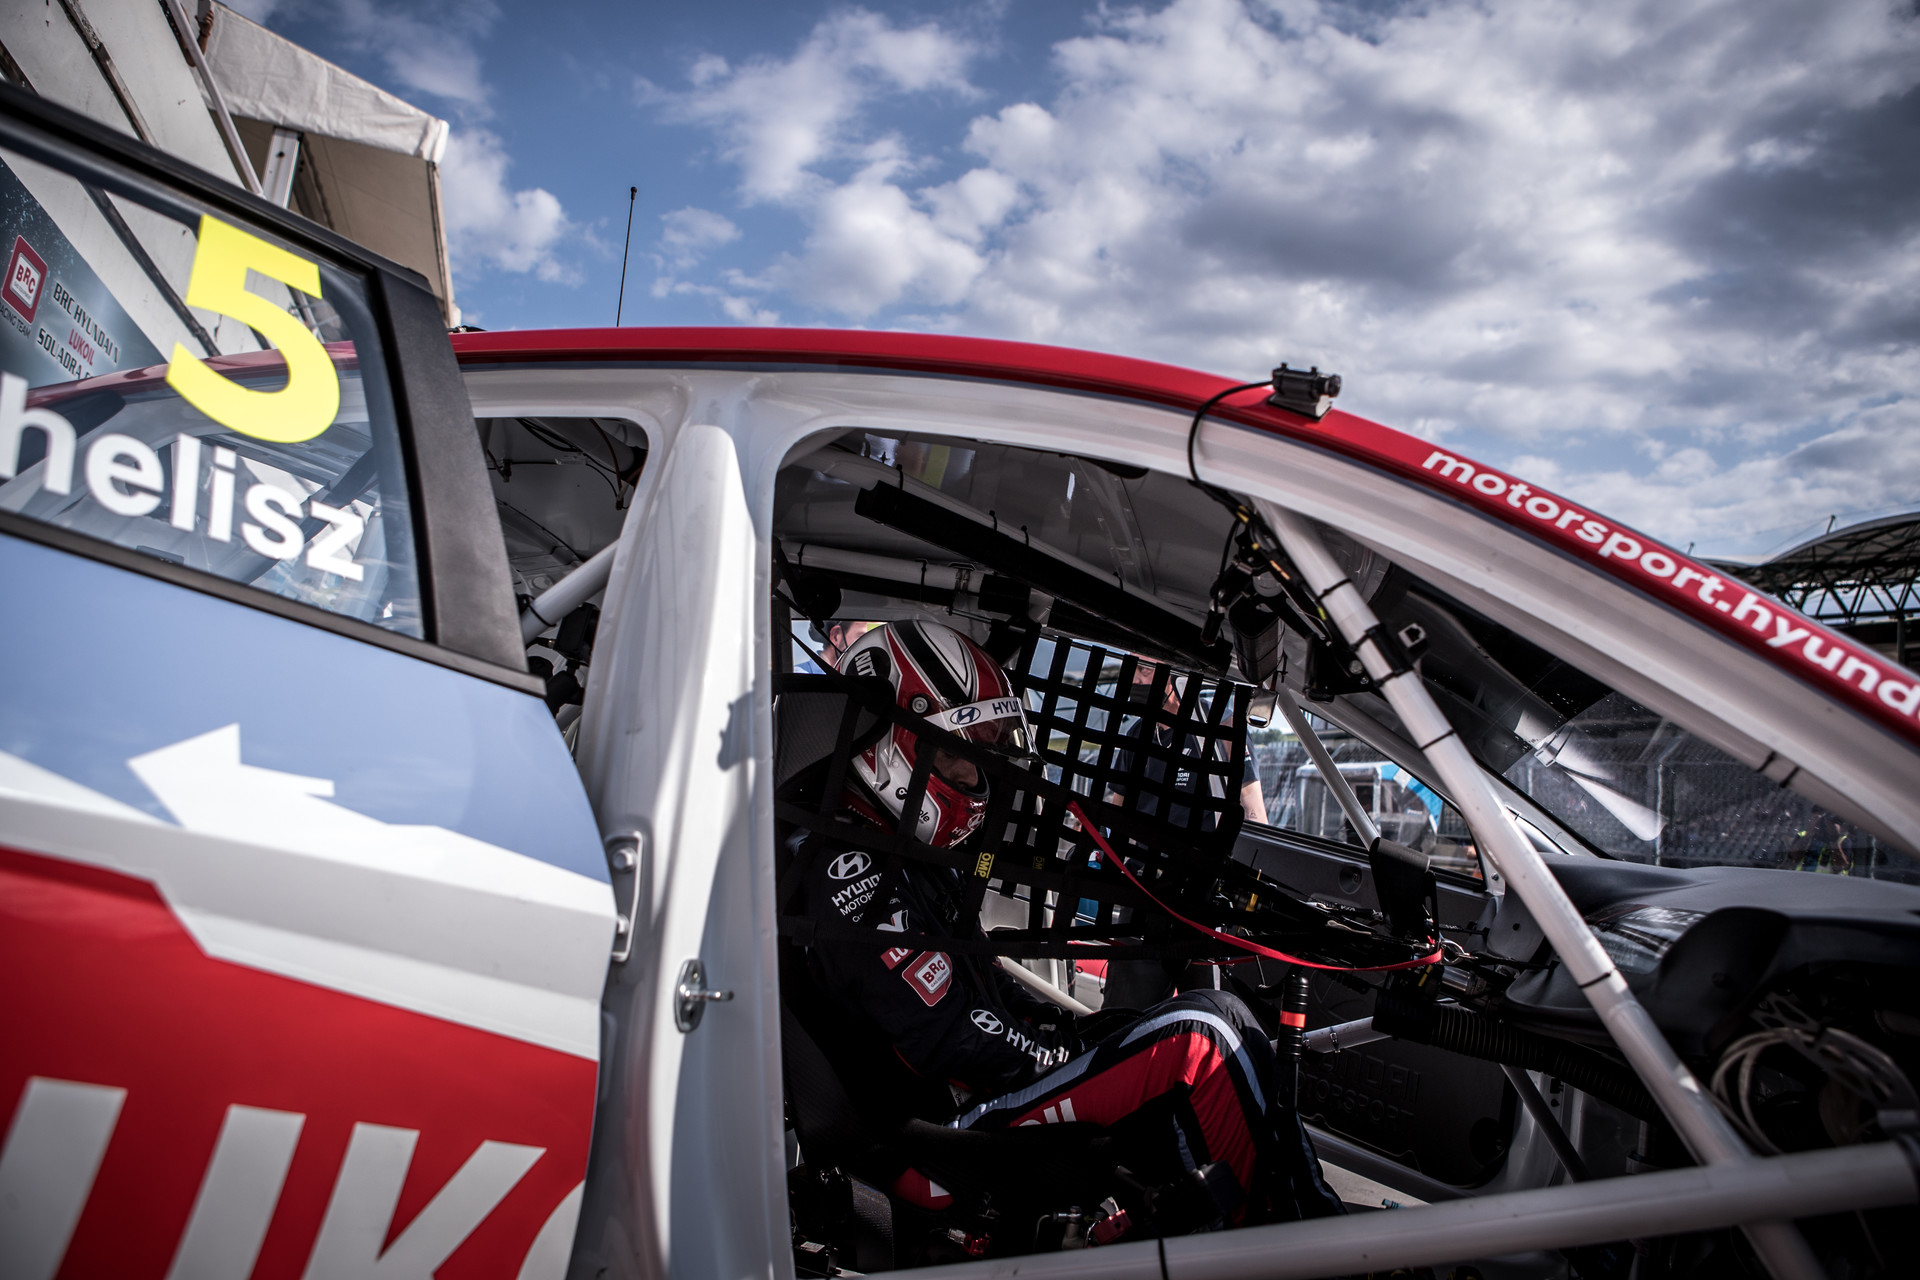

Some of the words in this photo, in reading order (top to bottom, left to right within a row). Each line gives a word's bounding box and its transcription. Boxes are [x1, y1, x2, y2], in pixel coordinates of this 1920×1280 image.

[16, 264, 36, 294] BRC
[0, 301, 18, 327] ACING
[53, 283, 75, 315] BRC
[73, 303, 114, 358] HYUNDAI
[166, 214, 340, 443] 5
[68, 328, 95, 366] LUKOIL
[0, 372, 365, 581] helisz
[1422, 451, 1920, 720] motorsport.hyund
[977, 852, 993, 878] OMP
[1034, 855, 1045, 871] OM
[831, 872, 884, 907] HYUND
[839, 890, 876, 916] MOTOR
[922, 960, 946, 984] BRC
